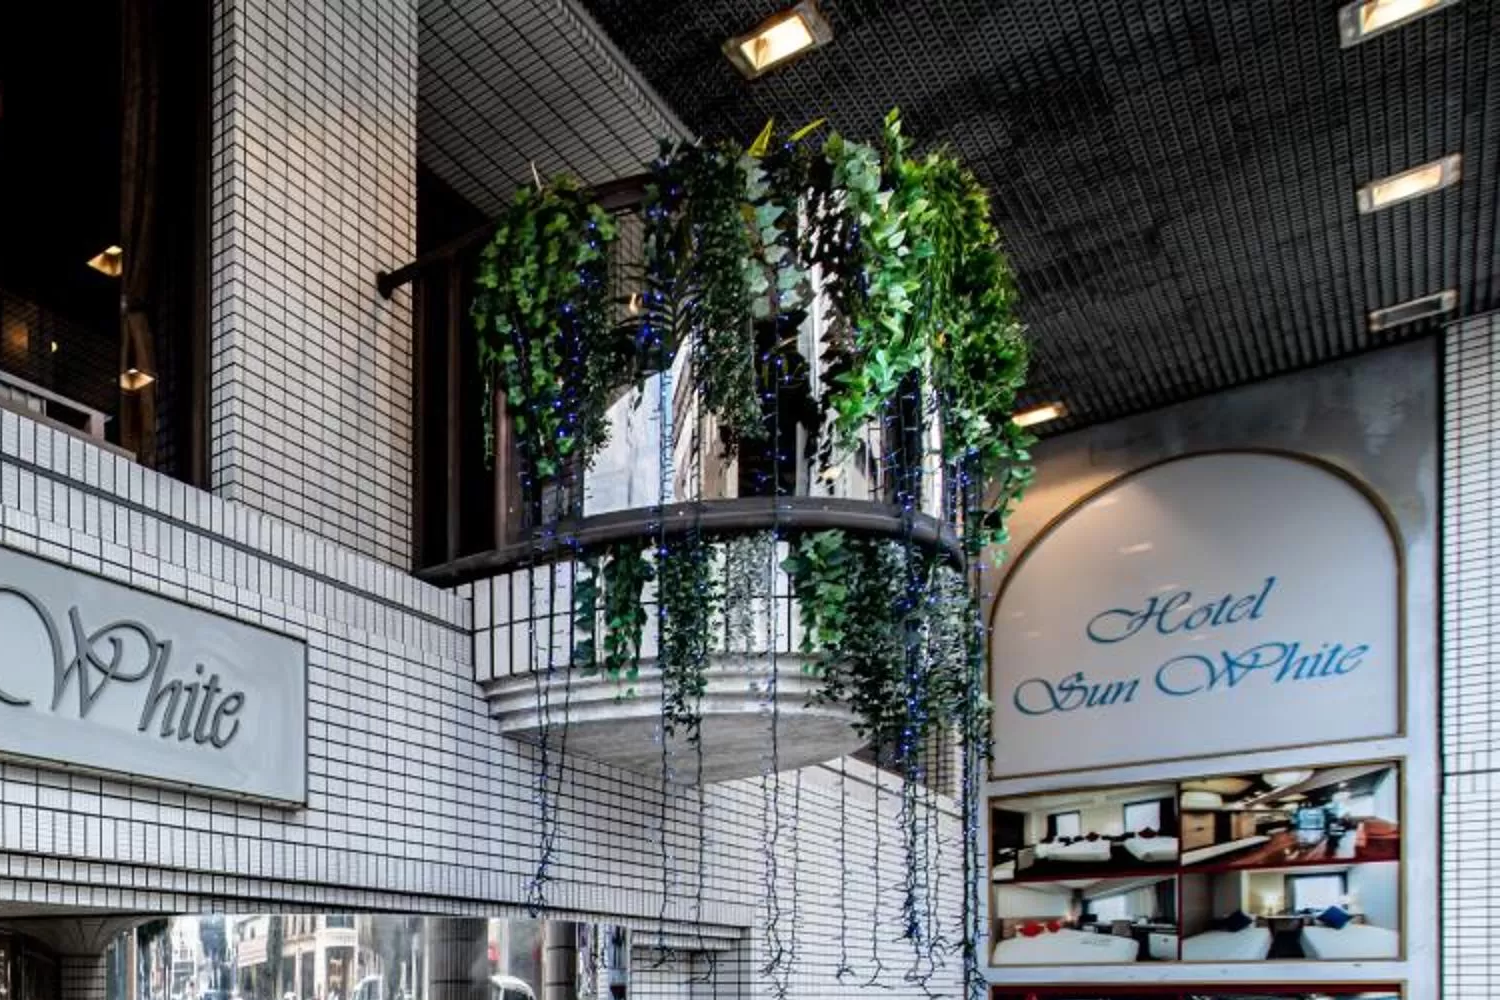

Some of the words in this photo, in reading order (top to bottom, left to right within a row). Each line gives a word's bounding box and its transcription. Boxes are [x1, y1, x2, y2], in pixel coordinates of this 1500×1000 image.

[1086, 576, 1277, 644] Hotel
[1013, 672, 1141, 716] Sun
[1155, 640, 1370, 697] White
